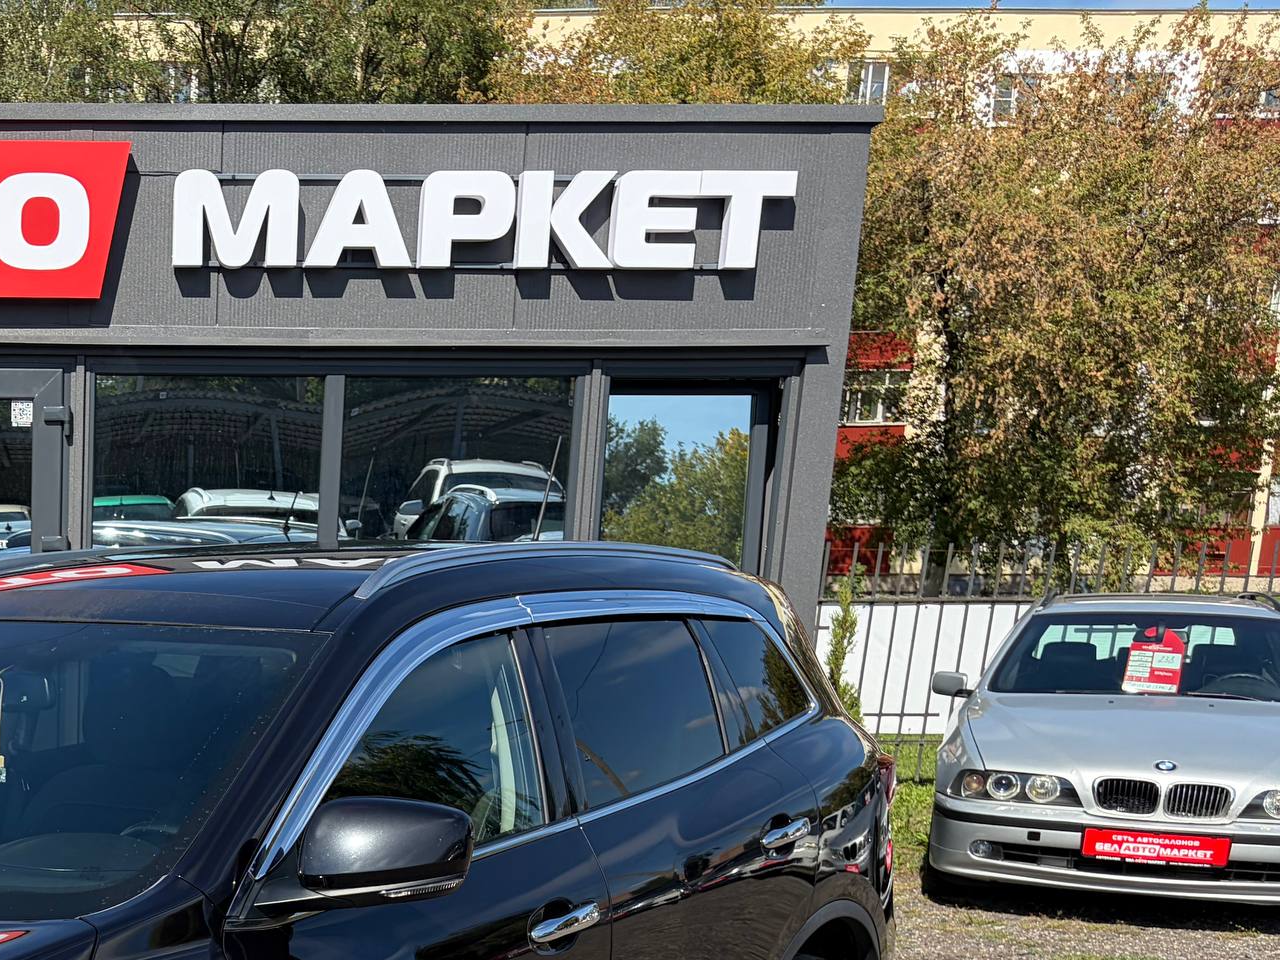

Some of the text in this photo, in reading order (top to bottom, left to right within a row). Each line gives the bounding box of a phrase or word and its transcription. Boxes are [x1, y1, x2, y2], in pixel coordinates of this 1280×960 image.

[172, 168, 798, 269] МАРКЕТ
[1136, 837, 1200, 846] АВТОСАЛОНОВ
[1160, 848, 1214, 858] МАРКЕТ
